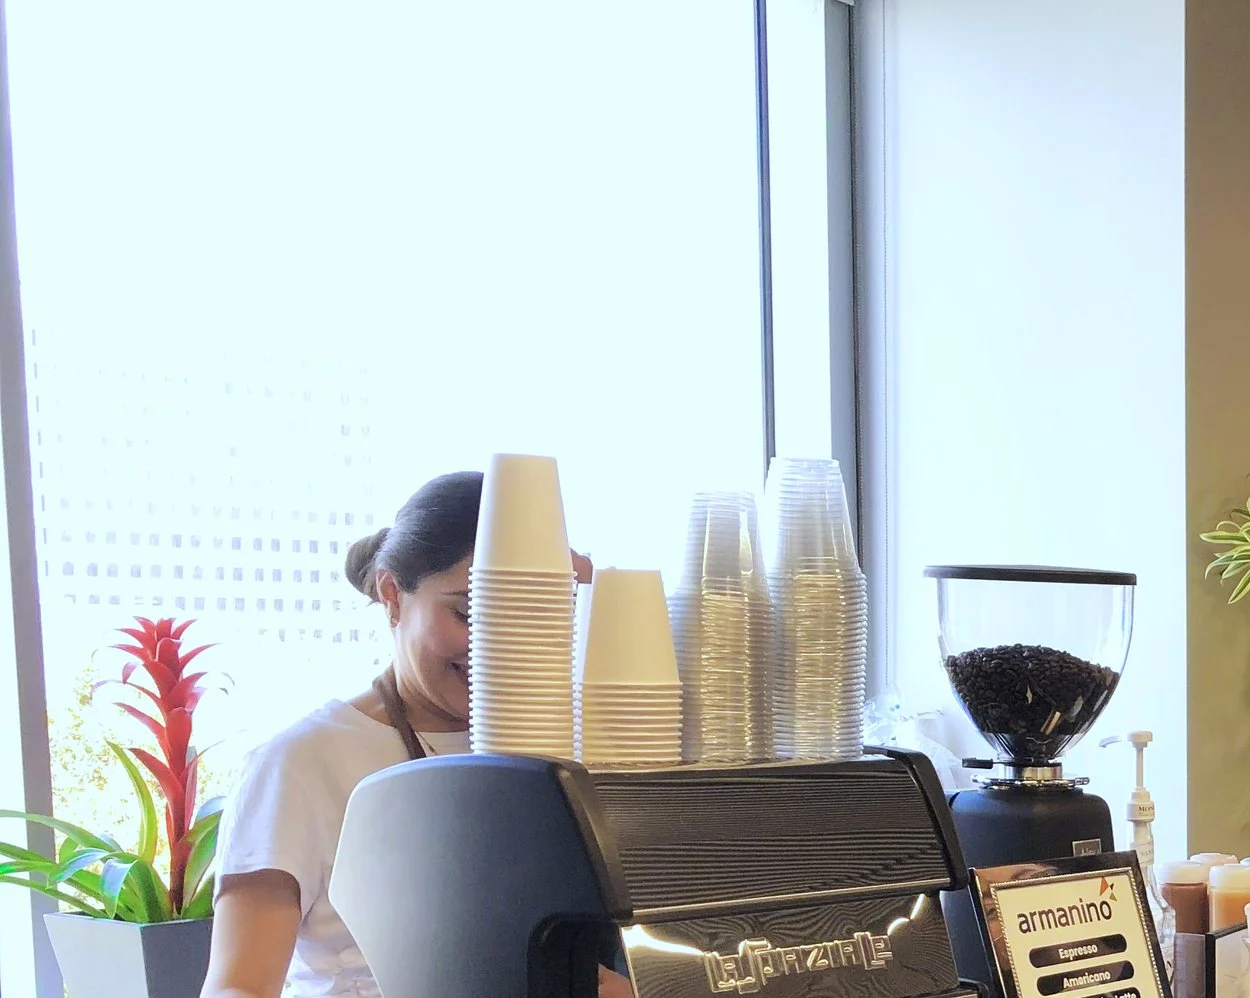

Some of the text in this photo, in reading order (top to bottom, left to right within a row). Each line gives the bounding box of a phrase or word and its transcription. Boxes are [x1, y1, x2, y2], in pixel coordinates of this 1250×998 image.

[1017, 897, 1112, 934] armanino
[1058, 944, 1098, 960] Espresso
[1063, 971, 1111, 988] Americano
